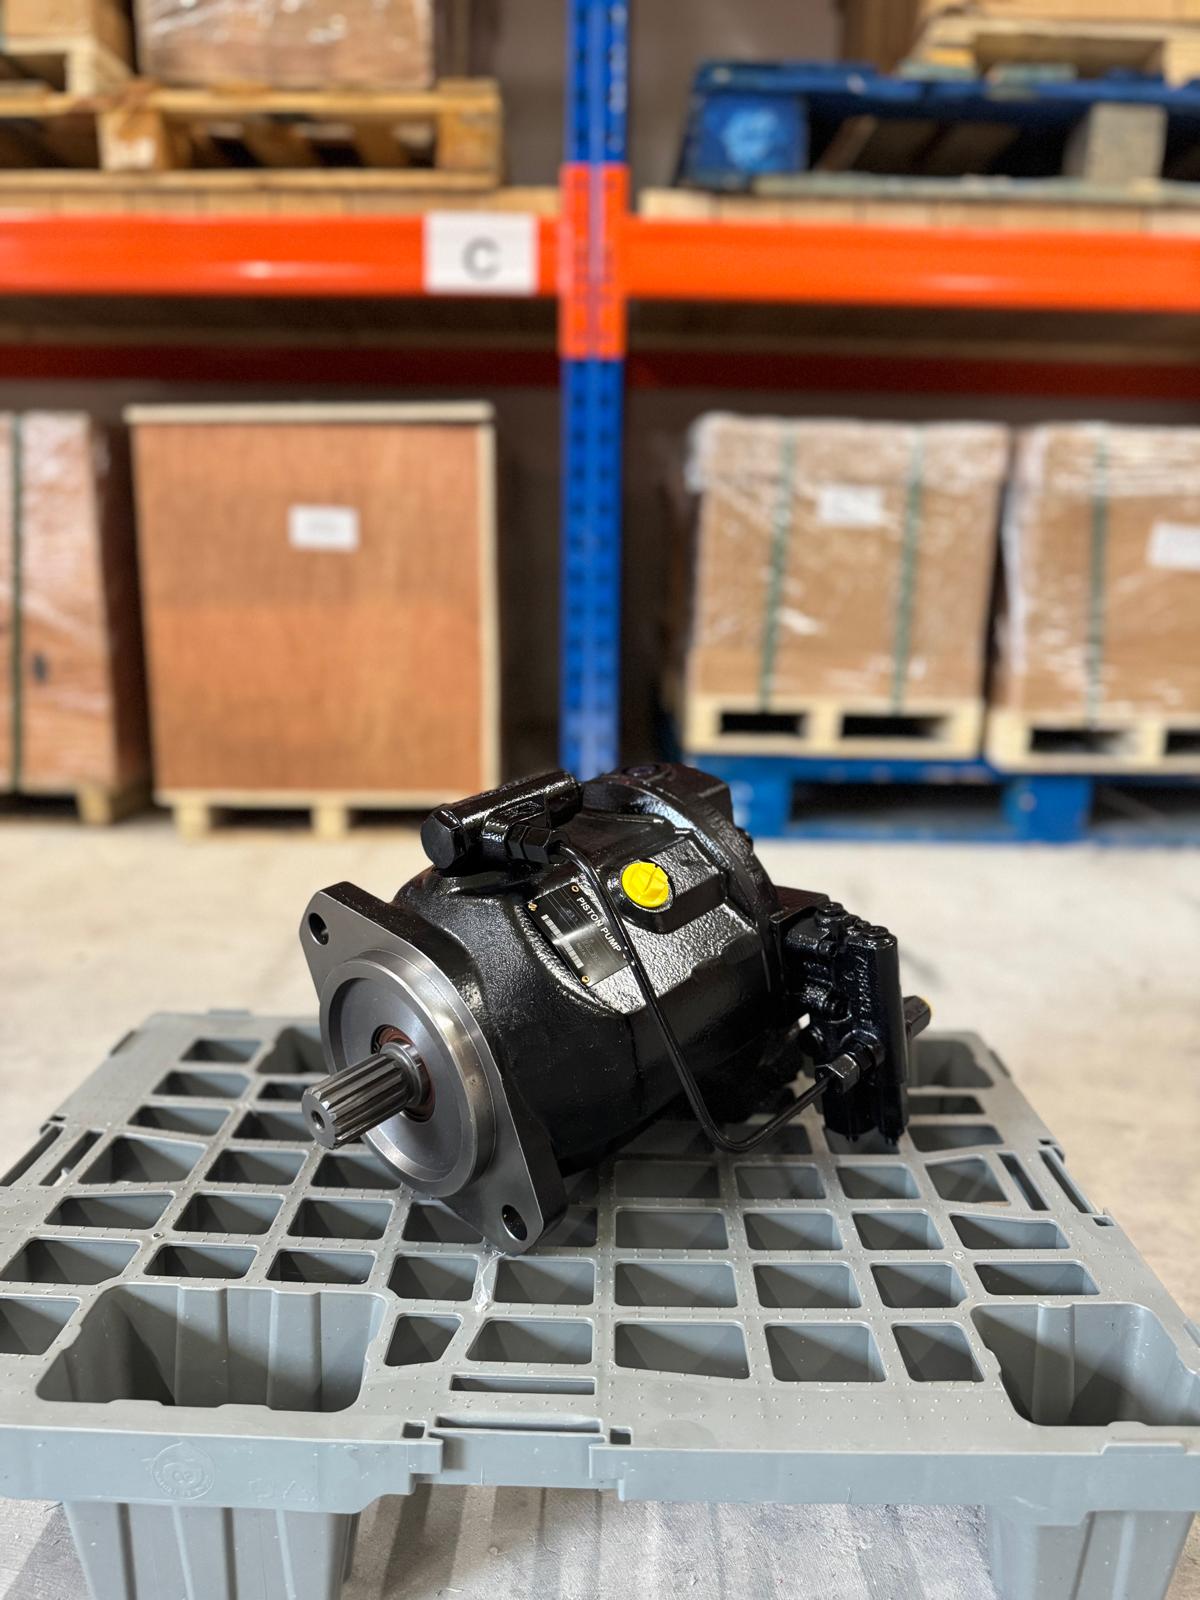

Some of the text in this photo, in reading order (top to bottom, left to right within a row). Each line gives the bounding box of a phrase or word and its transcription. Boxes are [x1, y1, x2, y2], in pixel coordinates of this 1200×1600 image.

[461, 237, 501, 281] C
[576, 897, 603, 928] PISTON
[601, 927, 621, 952] PUMP
